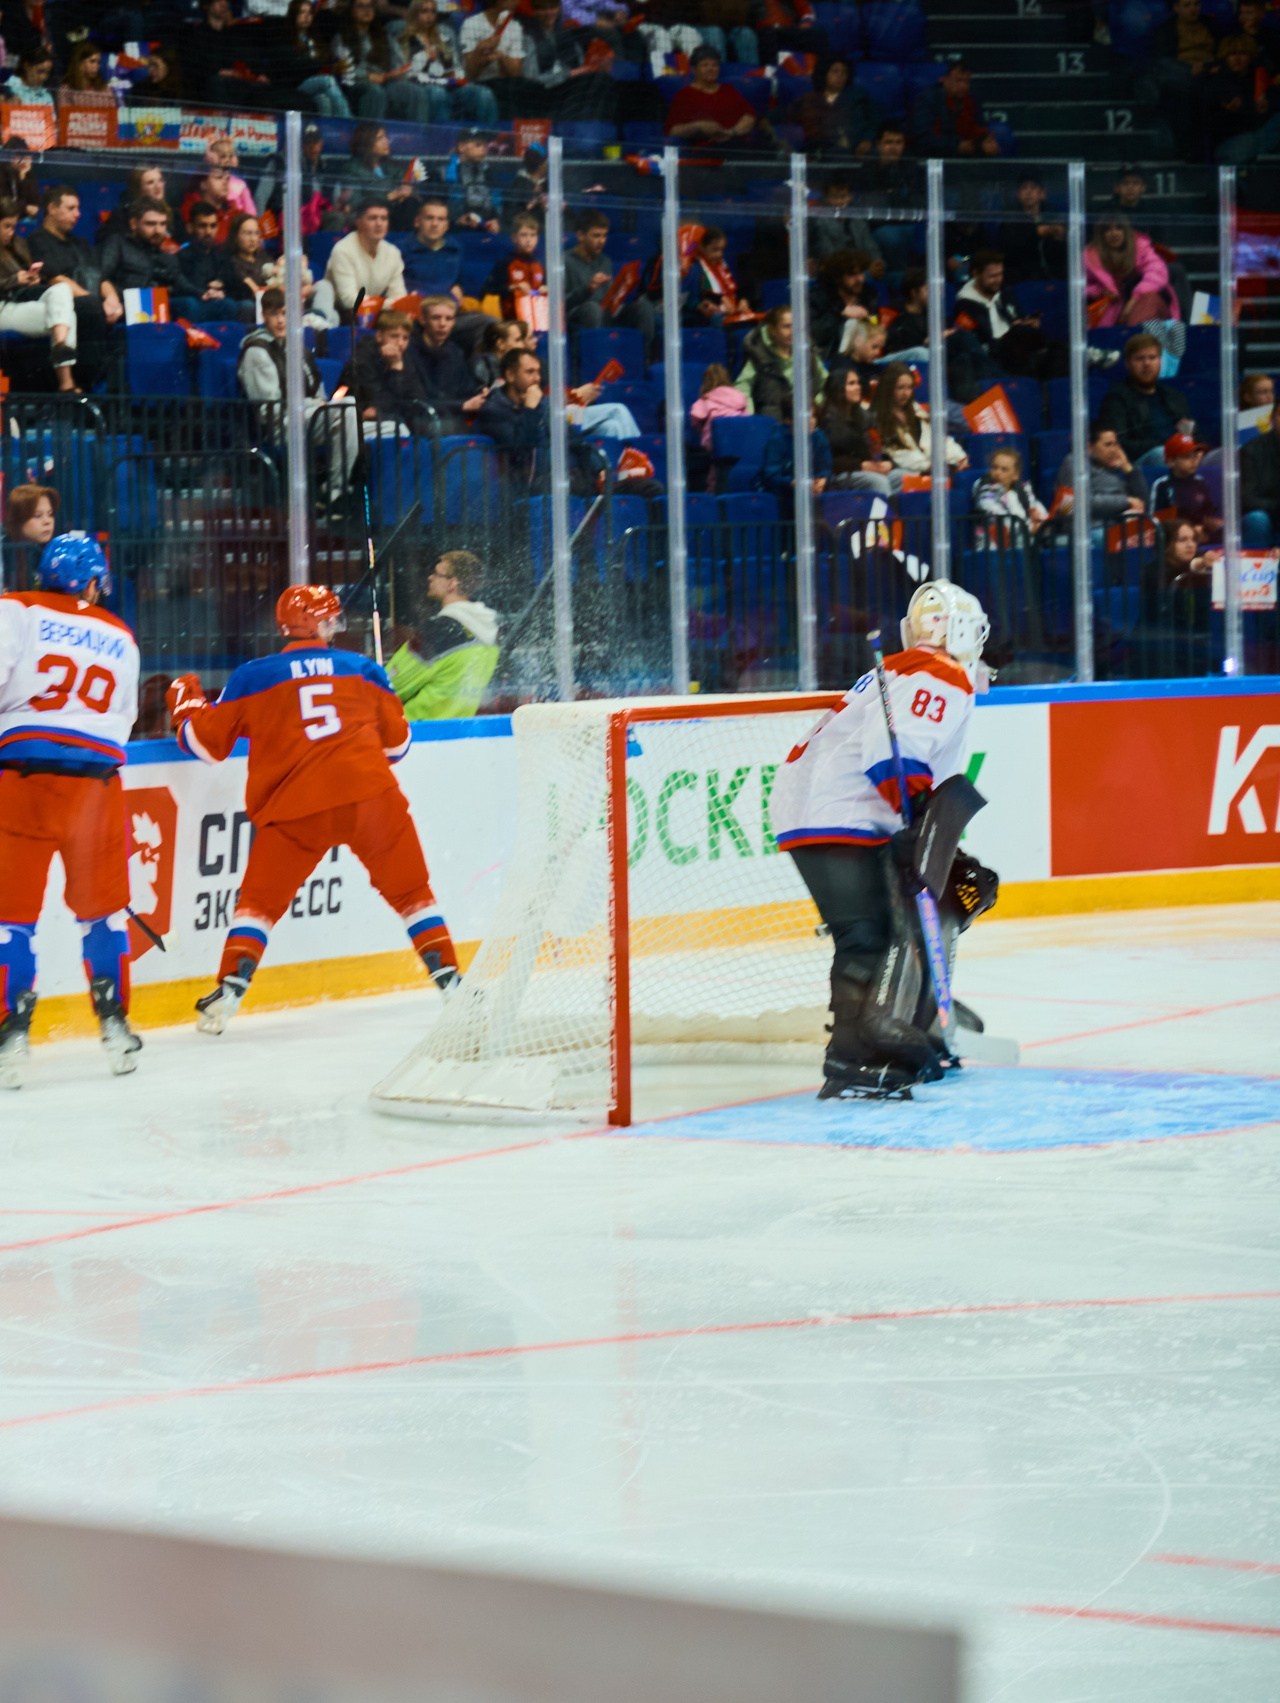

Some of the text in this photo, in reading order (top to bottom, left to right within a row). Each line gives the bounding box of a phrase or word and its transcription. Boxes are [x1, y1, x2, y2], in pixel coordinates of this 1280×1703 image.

[1056, 52, 1086, 75] 13
[1104, 109, 1134, 133] 12
[1154, 172, 1176, 196] 11
[298, 682, 342, 741] 5
[910, 688, 947, 723] 83
[194, 877, 342, 931] ЭКЕСС
